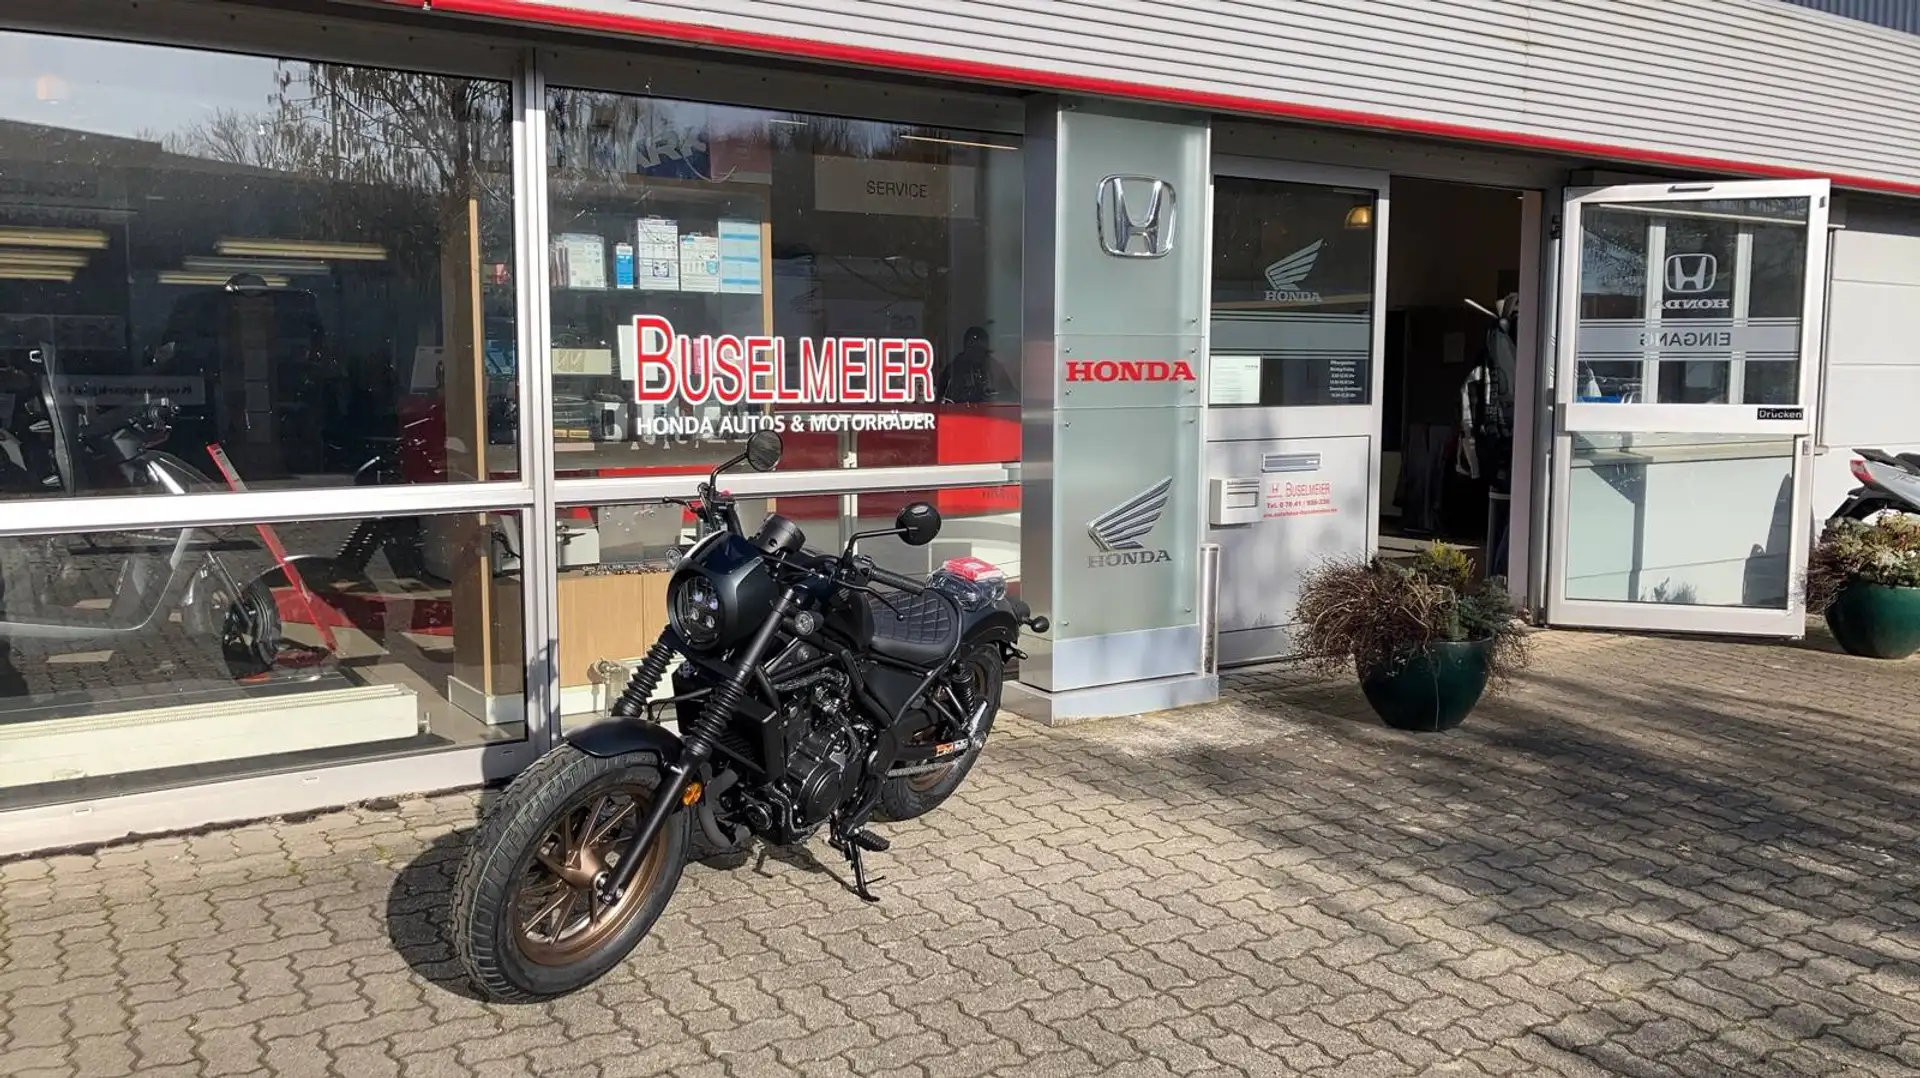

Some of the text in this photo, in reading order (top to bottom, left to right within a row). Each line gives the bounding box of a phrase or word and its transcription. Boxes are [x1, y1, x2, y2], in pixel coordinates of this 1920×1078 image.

[866, 179, 929, 198] SERVICE
[1264, 289, 1323, 303] HONDA
[1066, 360, 1196, 383] HONDA
[637, 411, 936, 435] HONDA AUTOS & MOTORRÄDER
[1759, 409, 1803, 420] Drücken
[1087, 550, 1172, 569] HONDA
